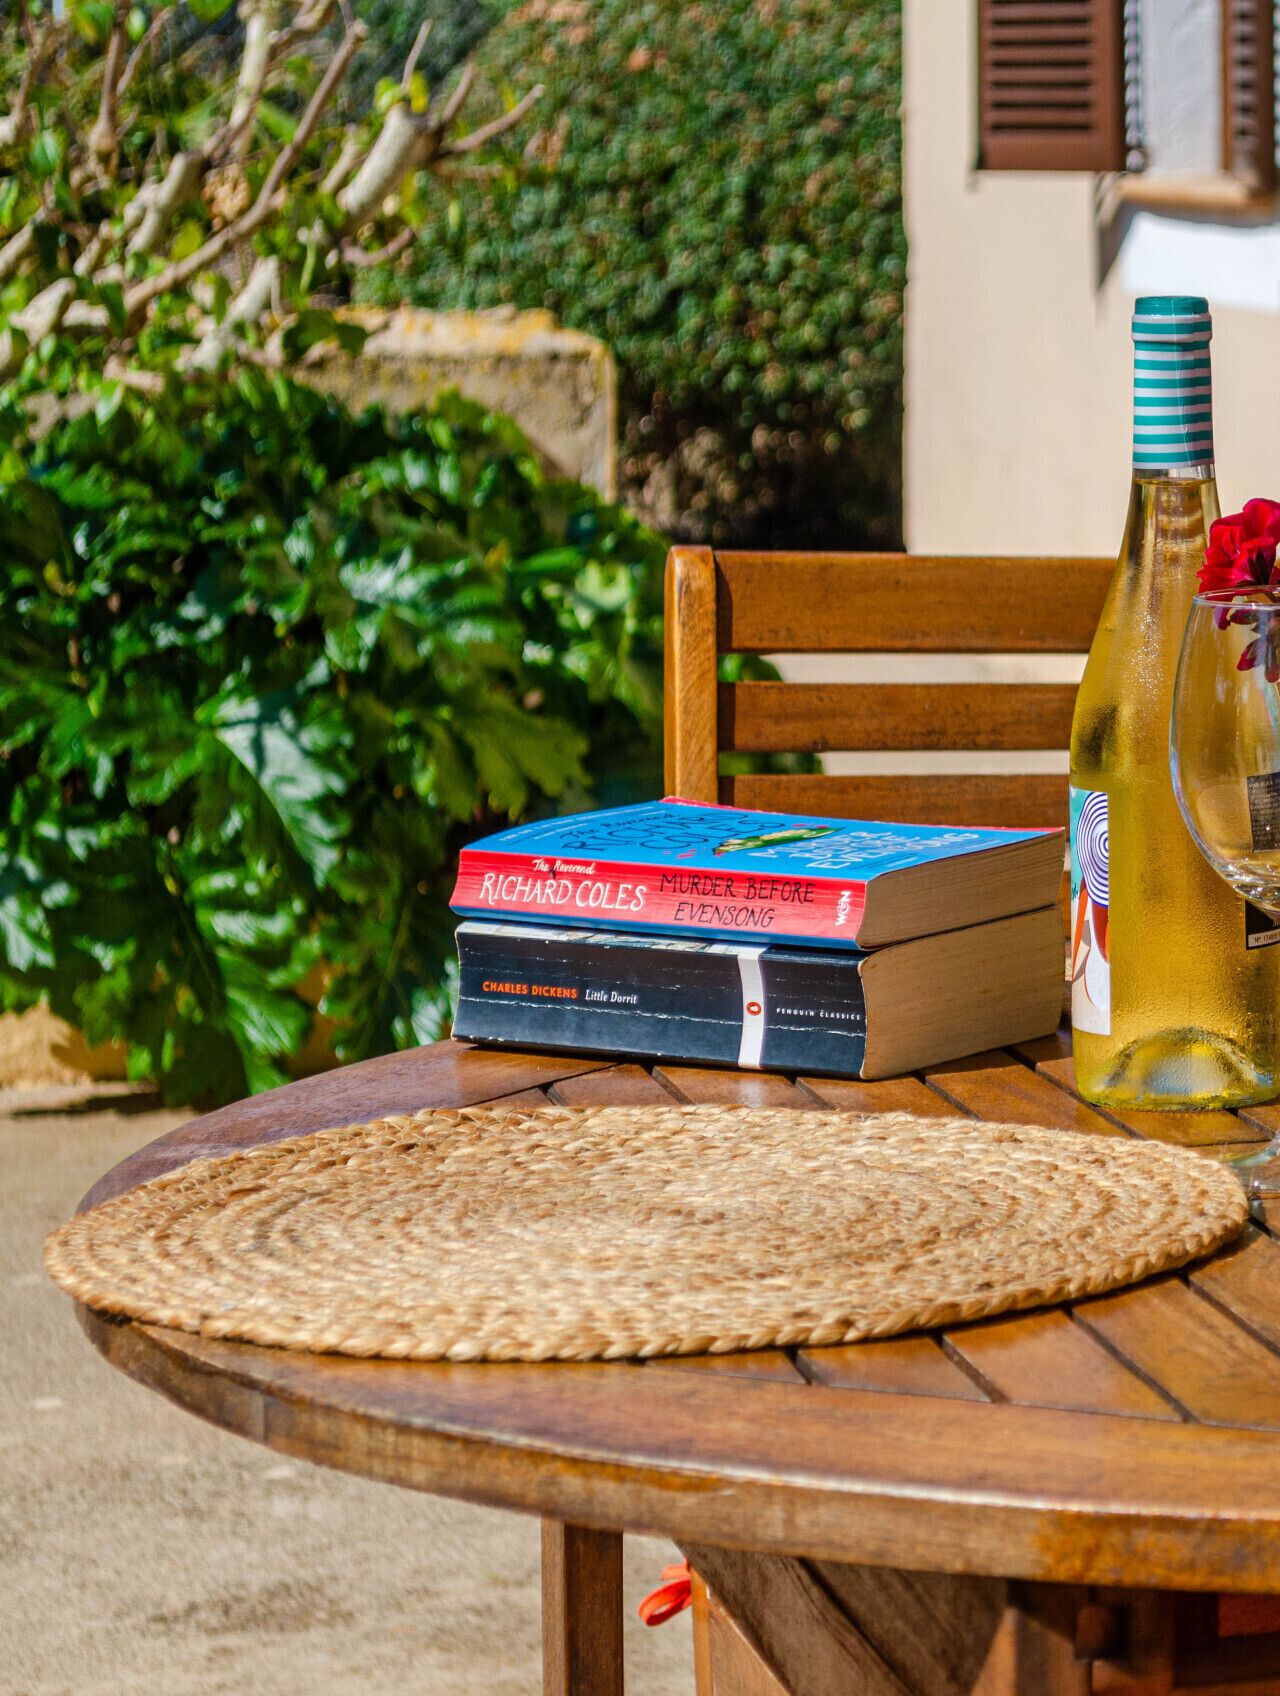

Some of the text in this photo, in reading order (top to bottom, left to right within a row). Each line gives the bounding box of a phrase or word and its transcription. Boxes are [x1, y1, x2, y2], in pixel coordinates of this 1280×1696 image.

[561, 813, 748, 851] RICHARD
[640, 820, 785, 849] COLES
[532, 858, 595, 875] The Reverend
[479, 872, 647, 912] RICHARD COLES
[659, 873, 816, 904] MURDER BEFORE
[673, 902, 775, 928] EVENSONG
[482, 981, 638, 1005] CHARLES DICKENS Little Dorrit
[776, 1008, 861, 1020] PENGUIN CLASSICS
